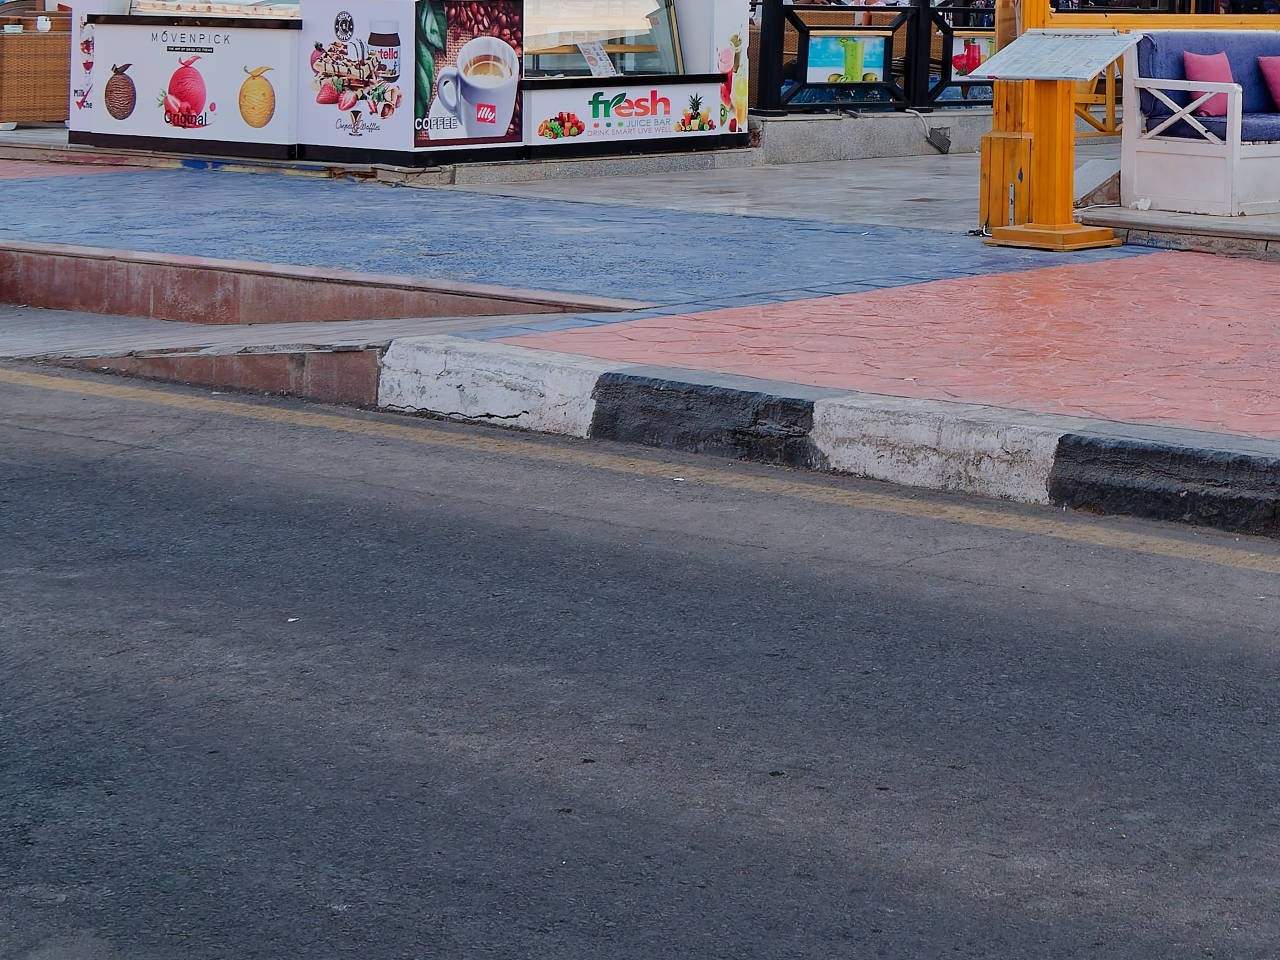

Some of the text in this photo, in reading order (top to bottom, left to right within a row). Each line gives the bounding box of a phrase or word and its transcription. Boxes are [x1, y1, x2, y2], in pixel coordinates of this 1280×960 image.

[379, 48, 398, 60] tella
[588, 90, 671, 118] fresh
[164, 111, 207, 127] Original
[478, 106, 496, 121] illy
[415, 117, 458, 130] COFFEE
[626, 118, 671, 128] JUICE BAR
[587, 129, 610, 137] DRINK
[611, 128, 636, 136] SMART
[637, 127, 653, 135] LIVE
